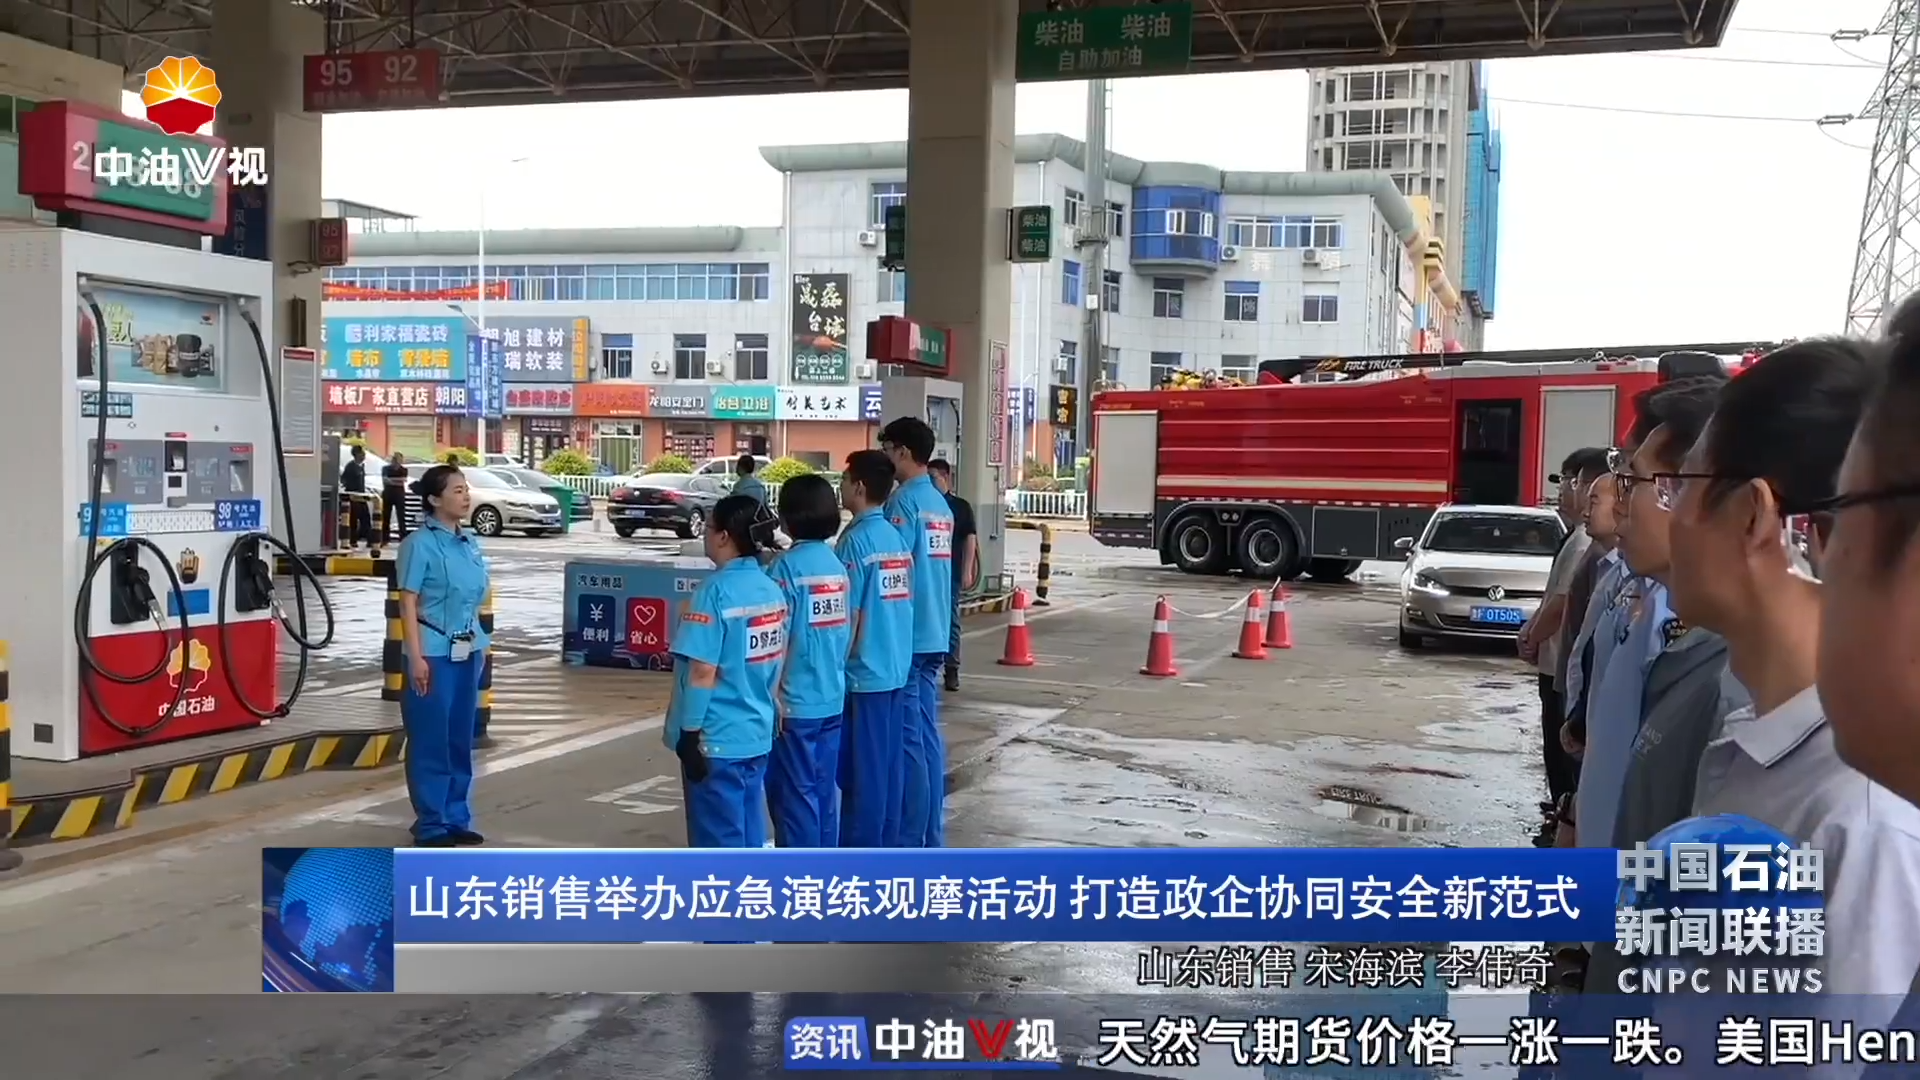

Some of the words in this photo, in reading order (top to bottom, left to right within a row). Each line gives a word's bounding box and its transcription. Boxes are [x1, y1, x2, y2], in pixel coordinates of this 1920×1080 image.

[1035, 18, 1084, 46] 柴油
[1120, 12, 1171, 40] 柴油
[1059, 45, 1142, 72] 自助加油
[320, 58, 353, 88] 95
[384, 55, 418, 83] 92
[72, 140, 90, 172] 2
[1022, 213, 1048, 228] 柴油
[1021, 238, 1047, 252] 柴油
[1343, 360, 1368, 372] FIRE
[1368, 358, 1404, 370] TRUCK
[329, 385, 429, 407] 墙板厂家直营店
[435, 386, 465, 406] 朝阳
[577, 574, 623, 589] 汽车用品
[582, 627, 609, 642] 便利
[629, 631, 658, 645] 省心
